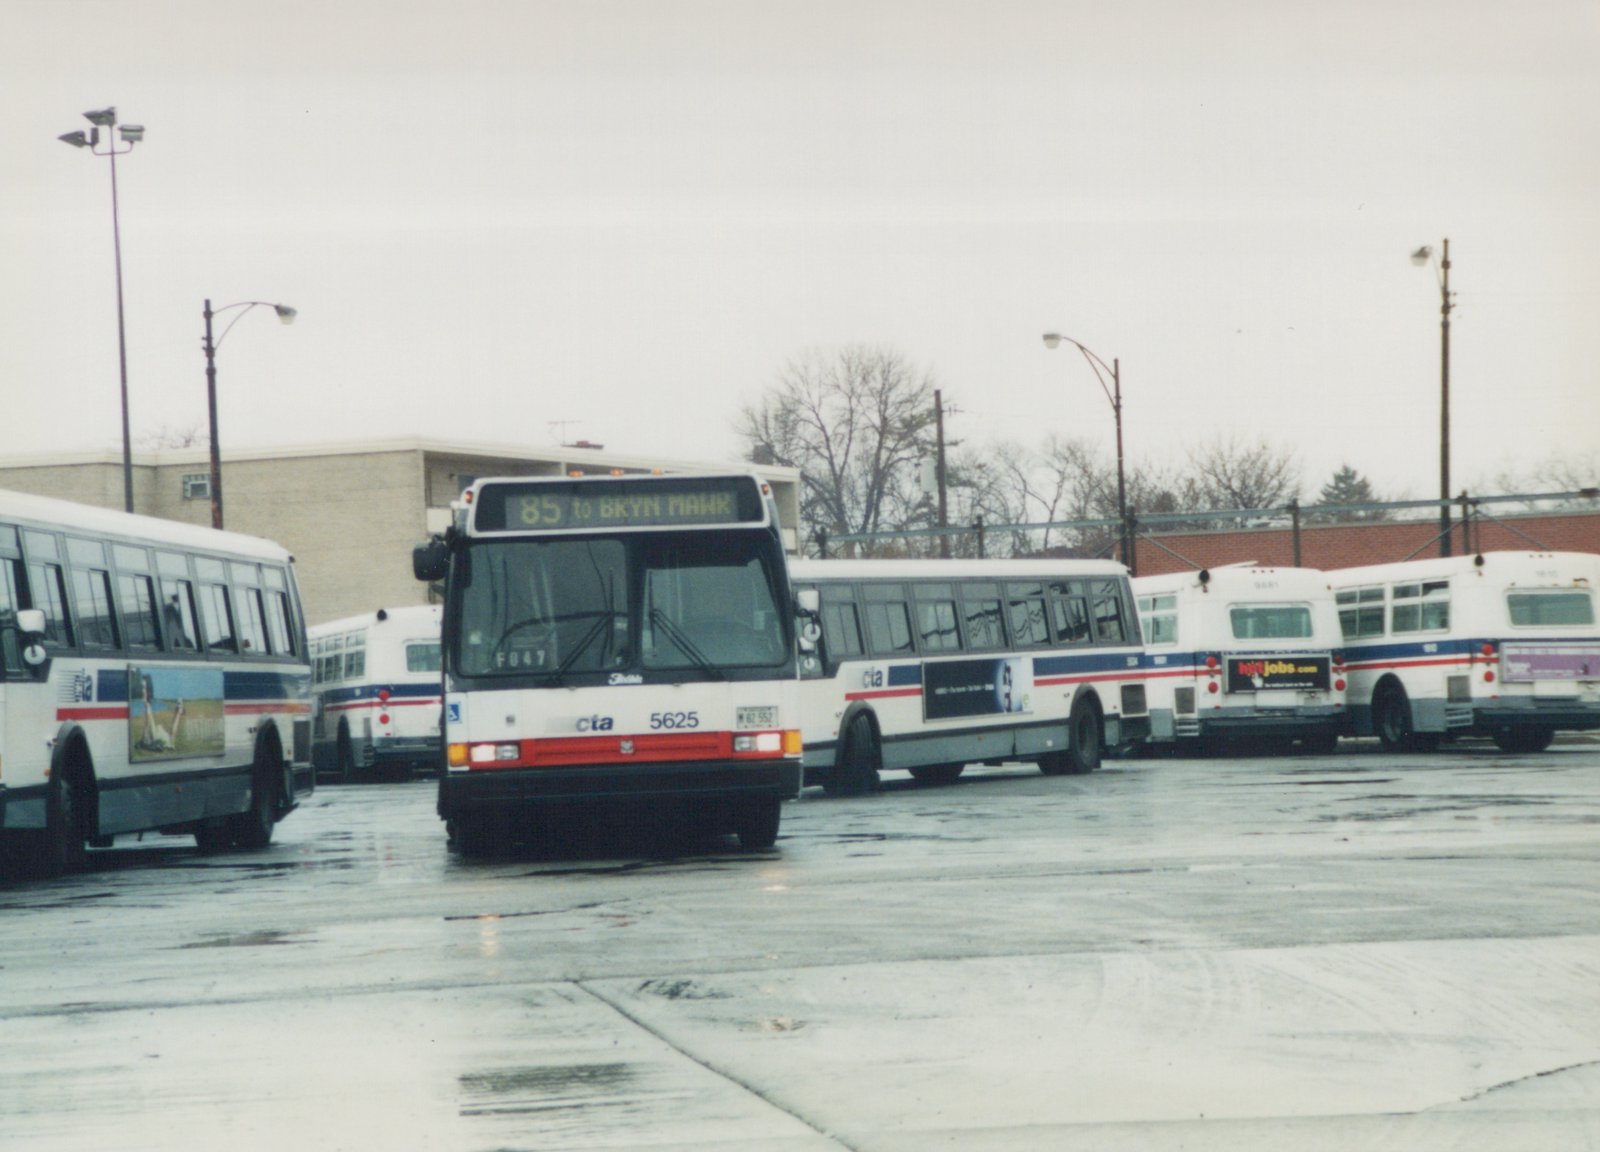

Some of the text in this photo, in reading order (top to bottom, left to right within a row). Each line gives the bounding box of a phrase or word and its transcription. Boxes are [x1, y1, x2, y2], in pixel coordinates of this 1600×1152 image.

[520, 496, 562, 525] 85
[572, 498, 592, 519] to
[575, 714, 614, 732] cta
[650, 712, 699, 729] 5625
